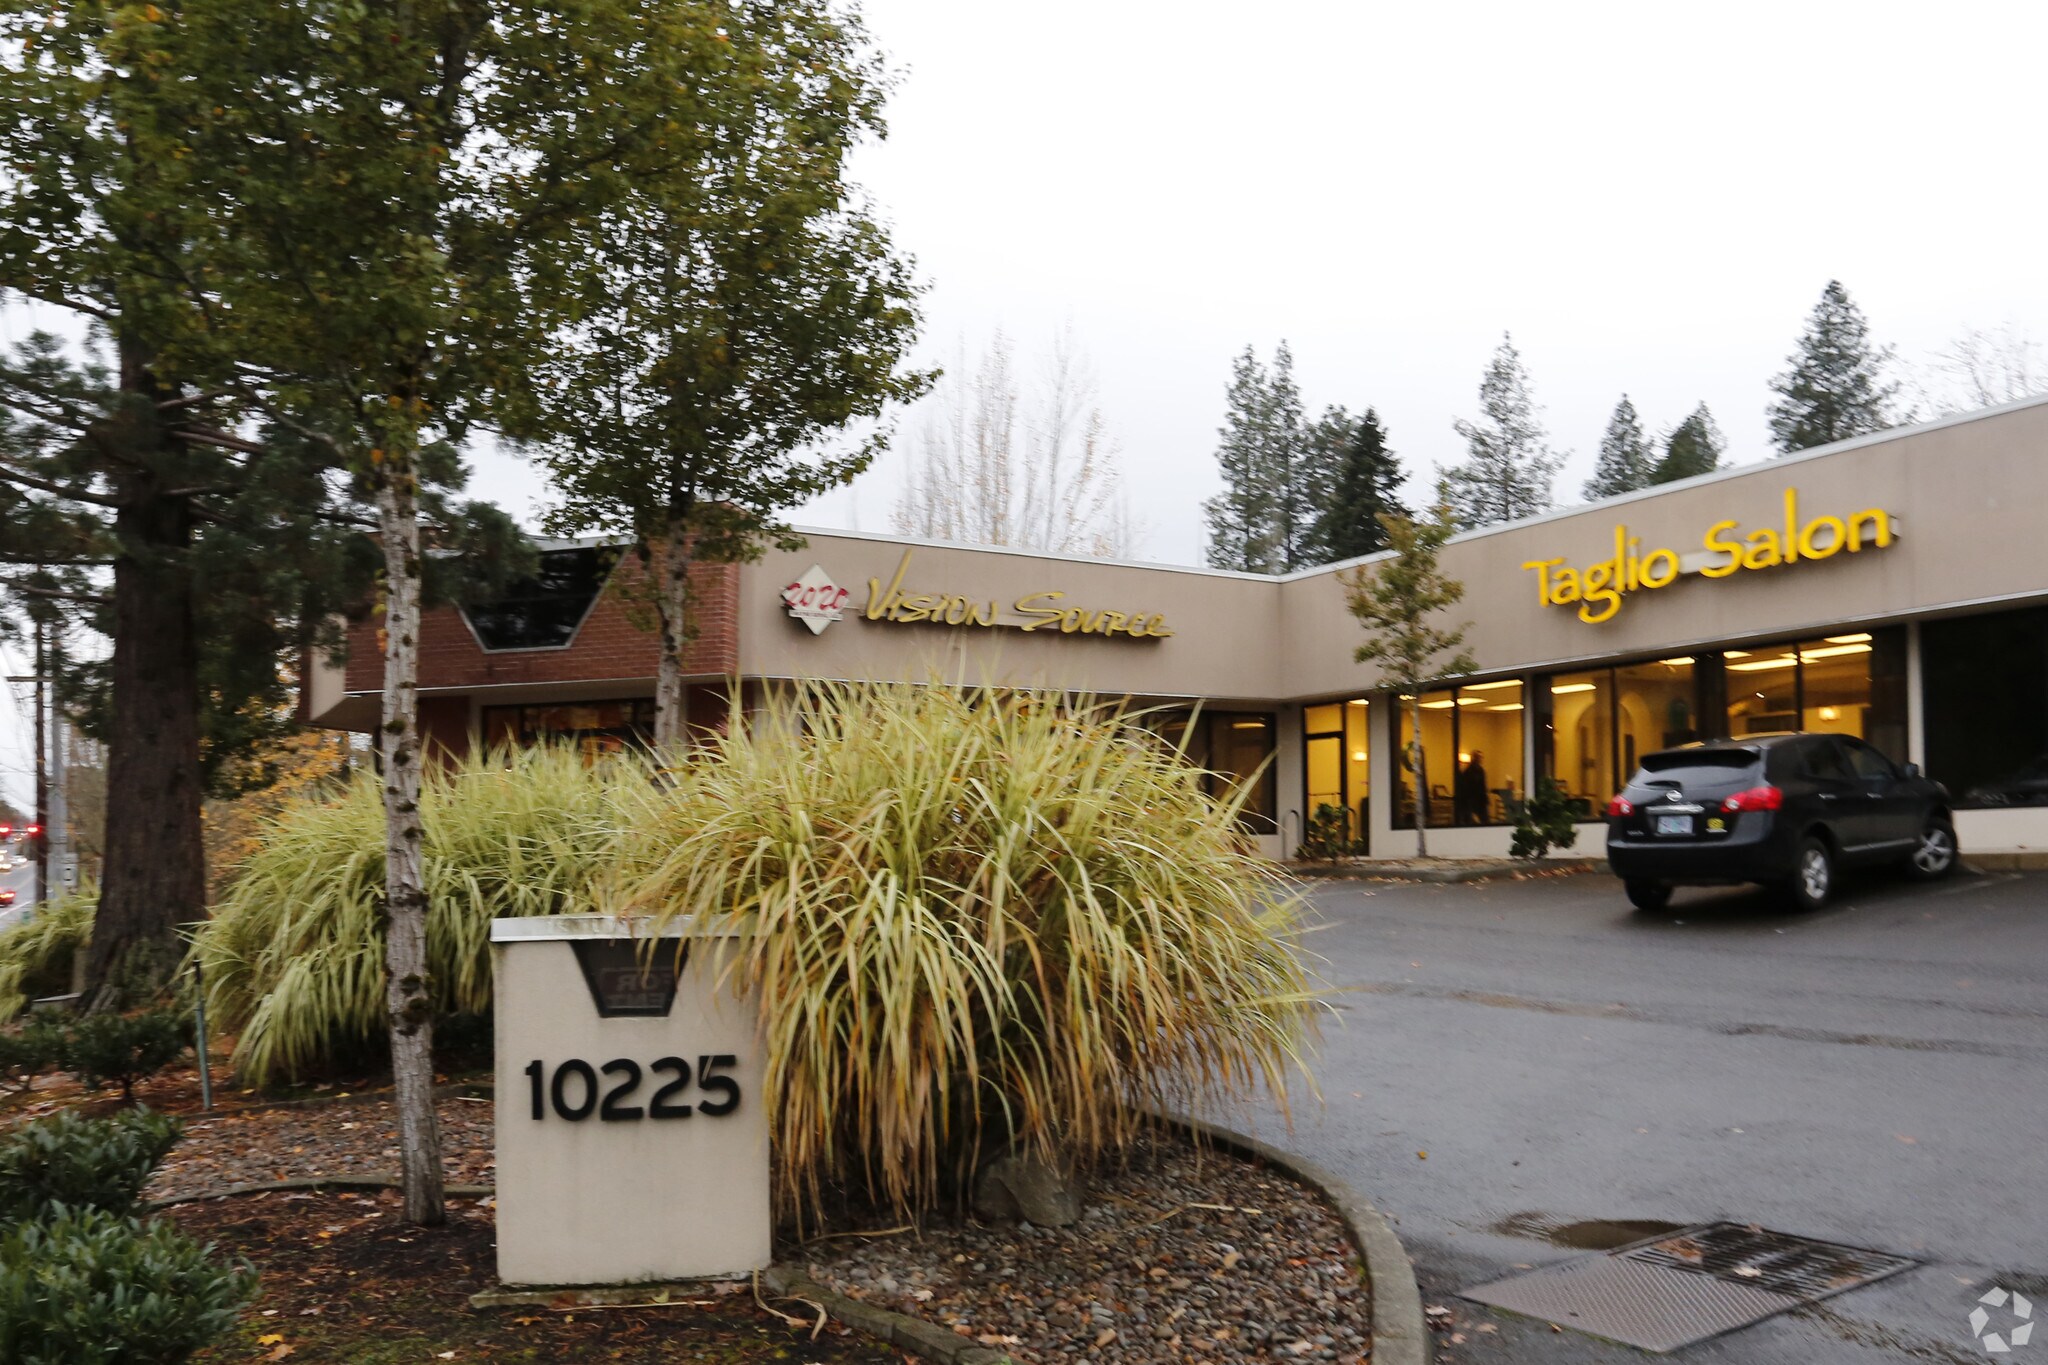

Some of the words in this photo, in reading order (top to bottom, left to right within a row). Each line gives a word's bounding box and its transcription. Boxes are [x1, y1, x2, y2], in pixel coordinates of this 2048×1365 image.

[1521, 525, 1681, 624] Taglio
[1699, 486, 1891, 578] Salon
[525, 1055, 741, 1122] 10225
